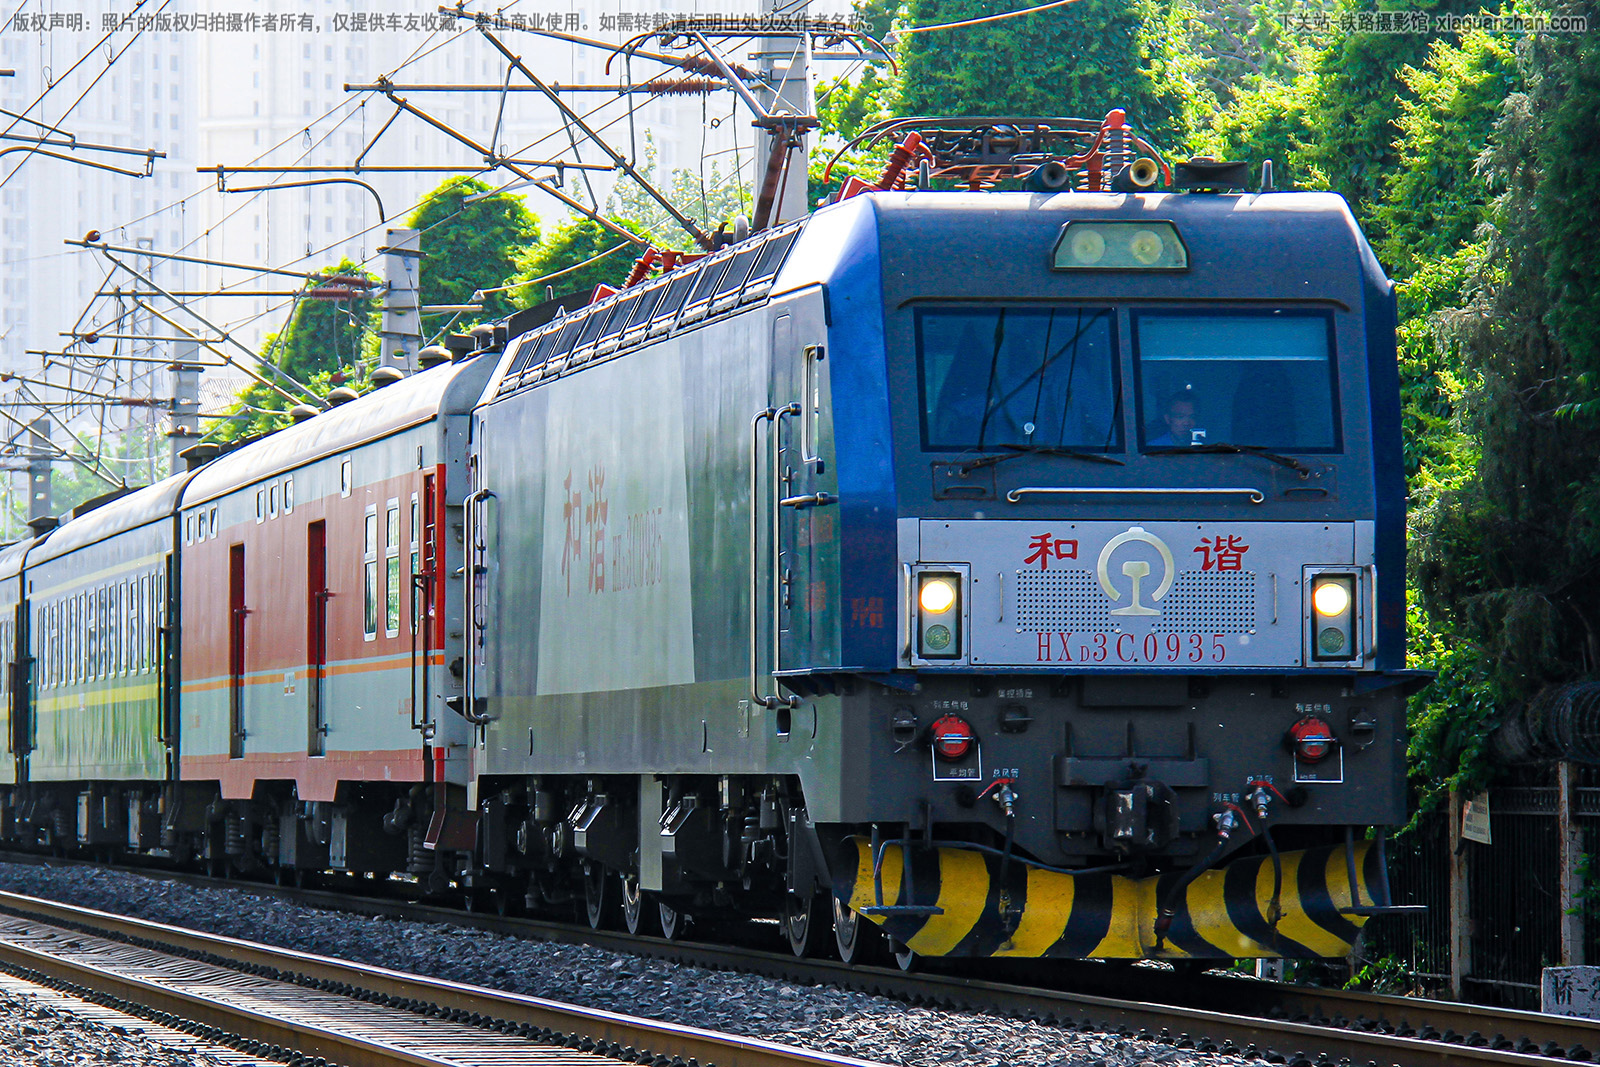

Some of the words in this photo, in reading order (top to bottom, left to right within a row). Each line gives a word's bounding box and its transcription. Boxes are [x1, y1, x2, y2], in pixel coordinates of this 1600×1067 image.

[562, 460, 608, 598] 和谐
[1296, 702, 1333, 714] 列车供电
[993, 768, 1020, 778] 总风管
[1213, 792, 1240, 803] 列车管
